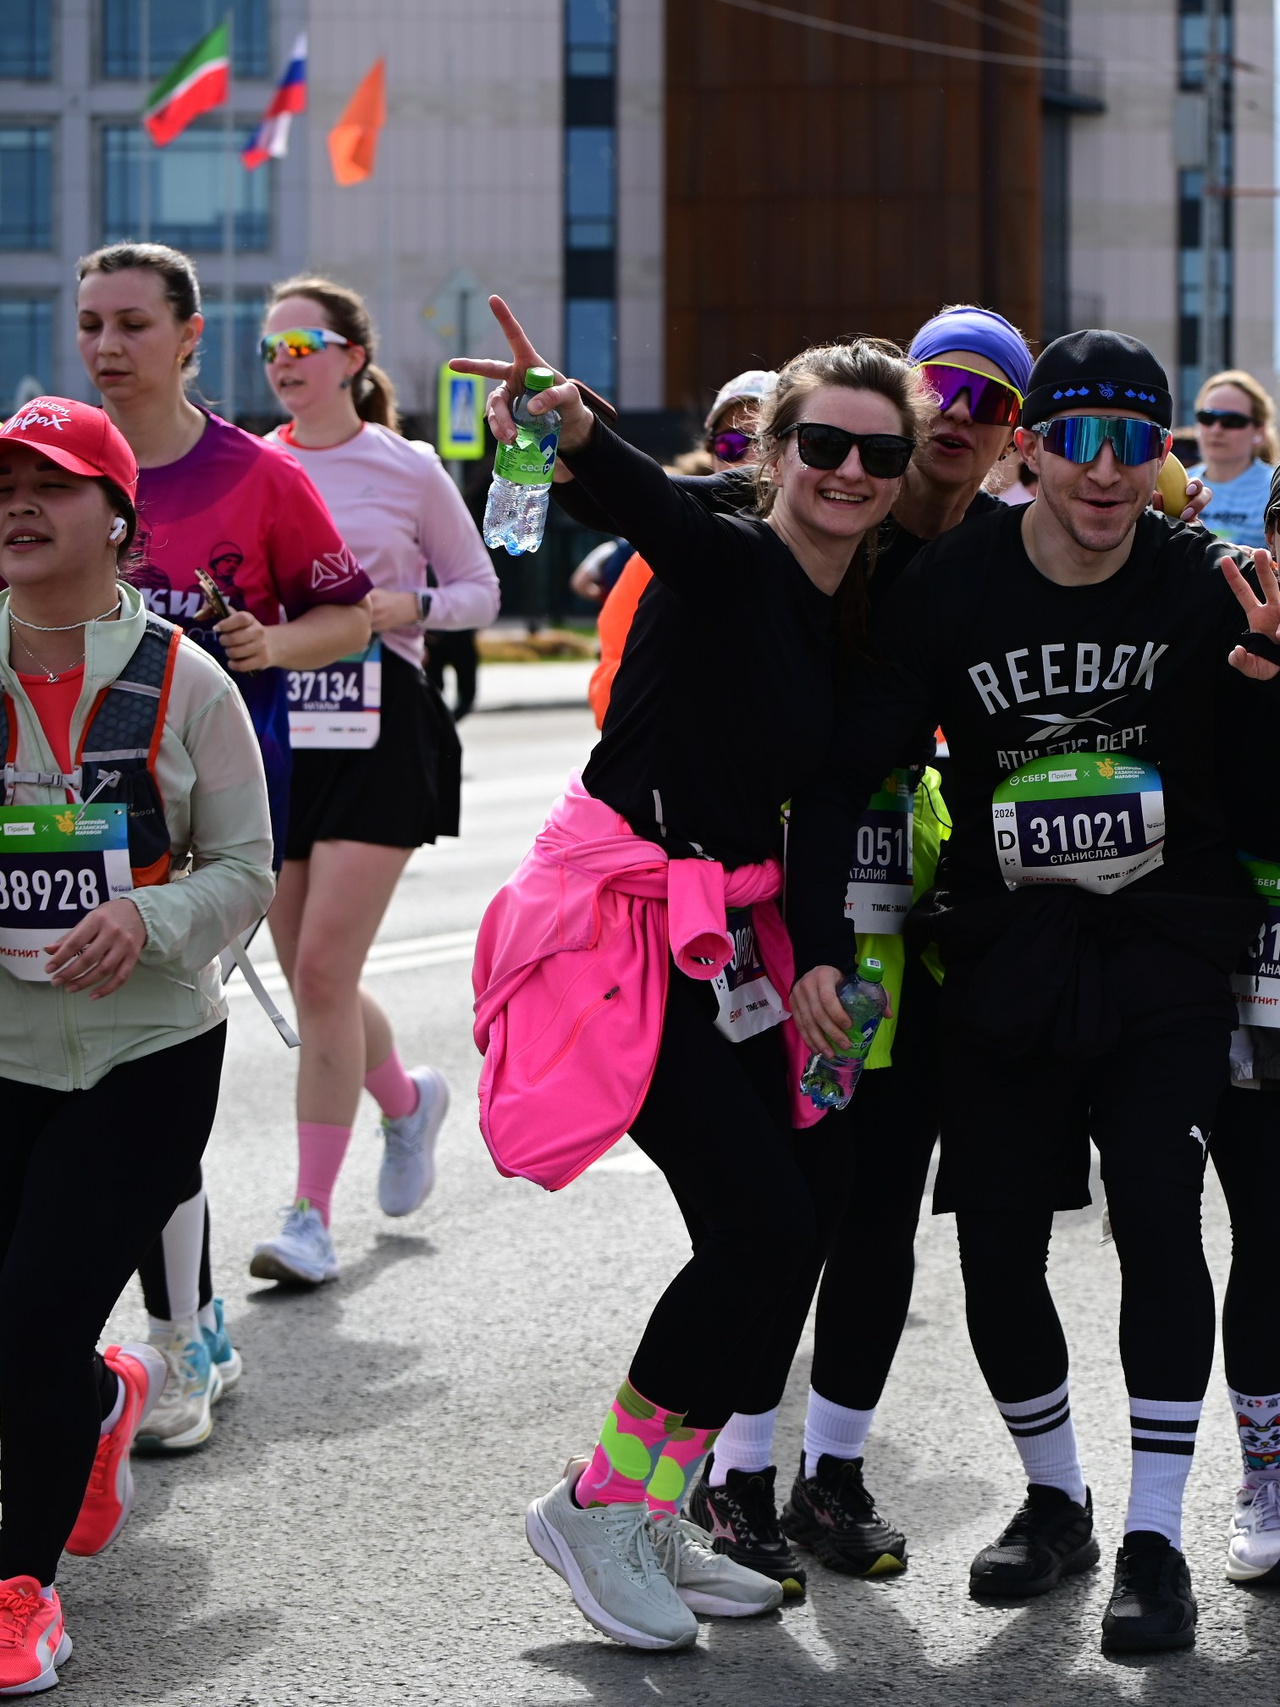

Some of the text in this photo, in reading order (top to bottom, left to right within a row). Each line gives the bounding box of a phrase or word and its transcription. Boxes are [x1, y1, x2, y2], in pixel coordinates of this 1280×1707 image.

[286, 671, 360, 702] 37134
[967, 641, 1170, 715] REEBOK
[1096, 725, 1148, 753] DEPT.
[1021, 772, 1073, 783] СБЕР Прайм
[994, 808, 1015, 819] 2026
[997, 830, 1016, 850] D
[1029, 810, 1133, 854] 31021
[856, 825, 904, 867] 051
[1050, 848, 1119, 864] СТАНИСЛАВ
[0, 947, 40, 958] МАГНИТ
[1241, 994, 1279, 1006] МАГНИТ
